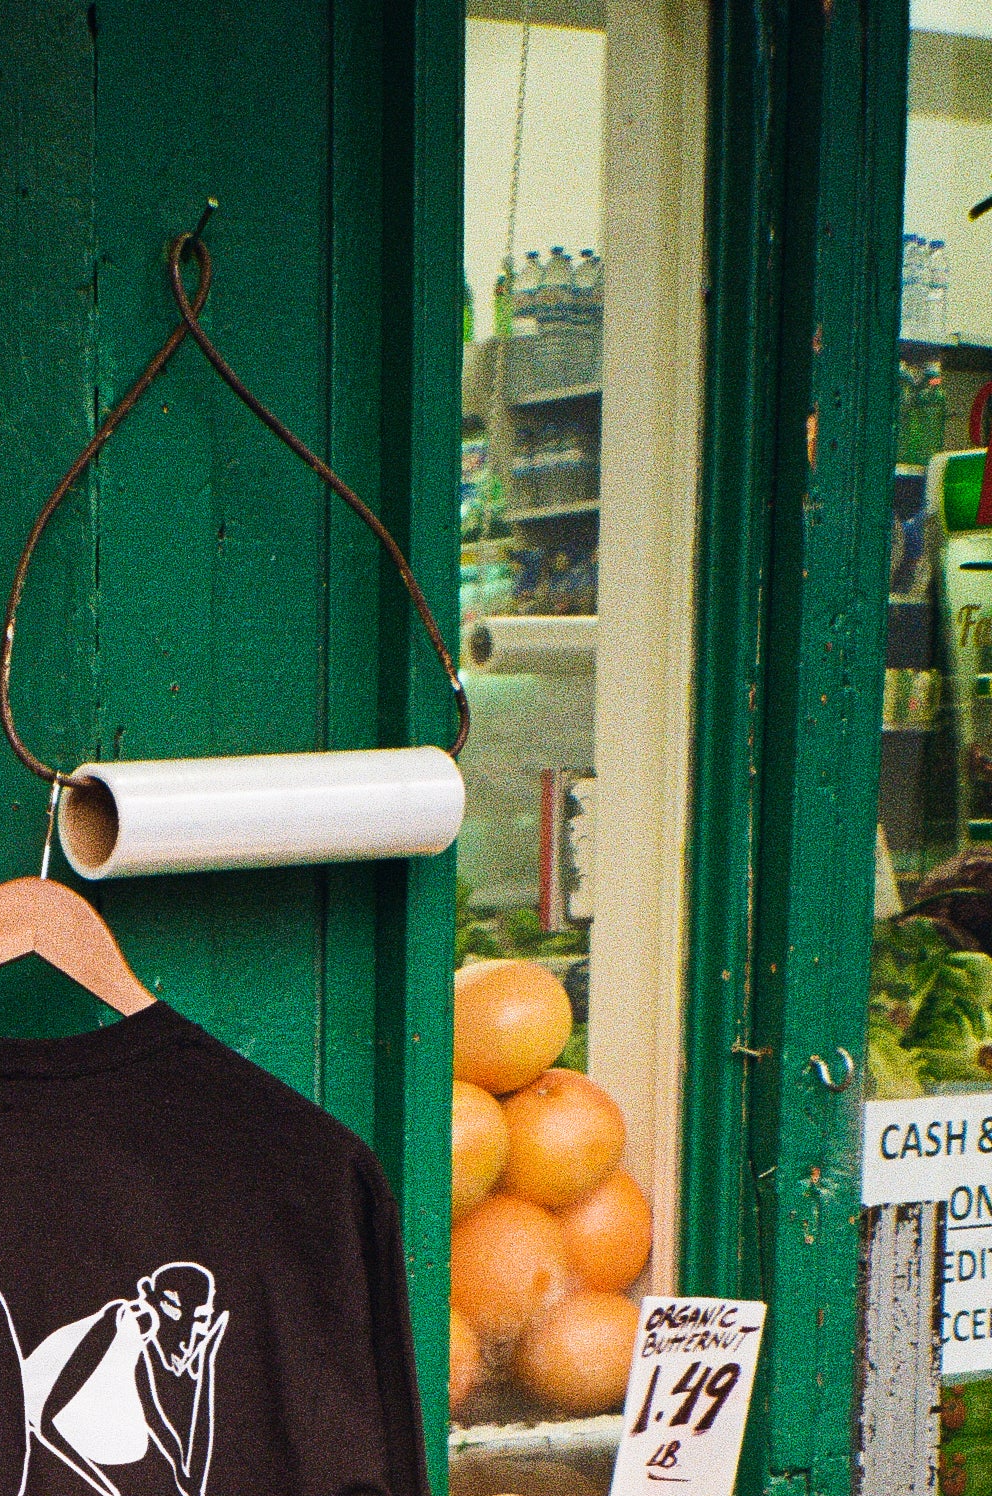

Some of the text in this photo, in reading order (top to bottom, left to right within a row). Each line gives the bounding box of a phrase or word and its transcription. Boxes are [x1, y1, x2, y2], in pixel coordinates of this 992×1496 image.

[880, 1120, 967, 1160] CASH
[645, 1304, 738, 1331] ORGANIC
[642, 1326, 760, 1357] BUTTERNUT
[630, 1361, 741, 1436] 1.49
[646, 1440, 681, 1468] LB
